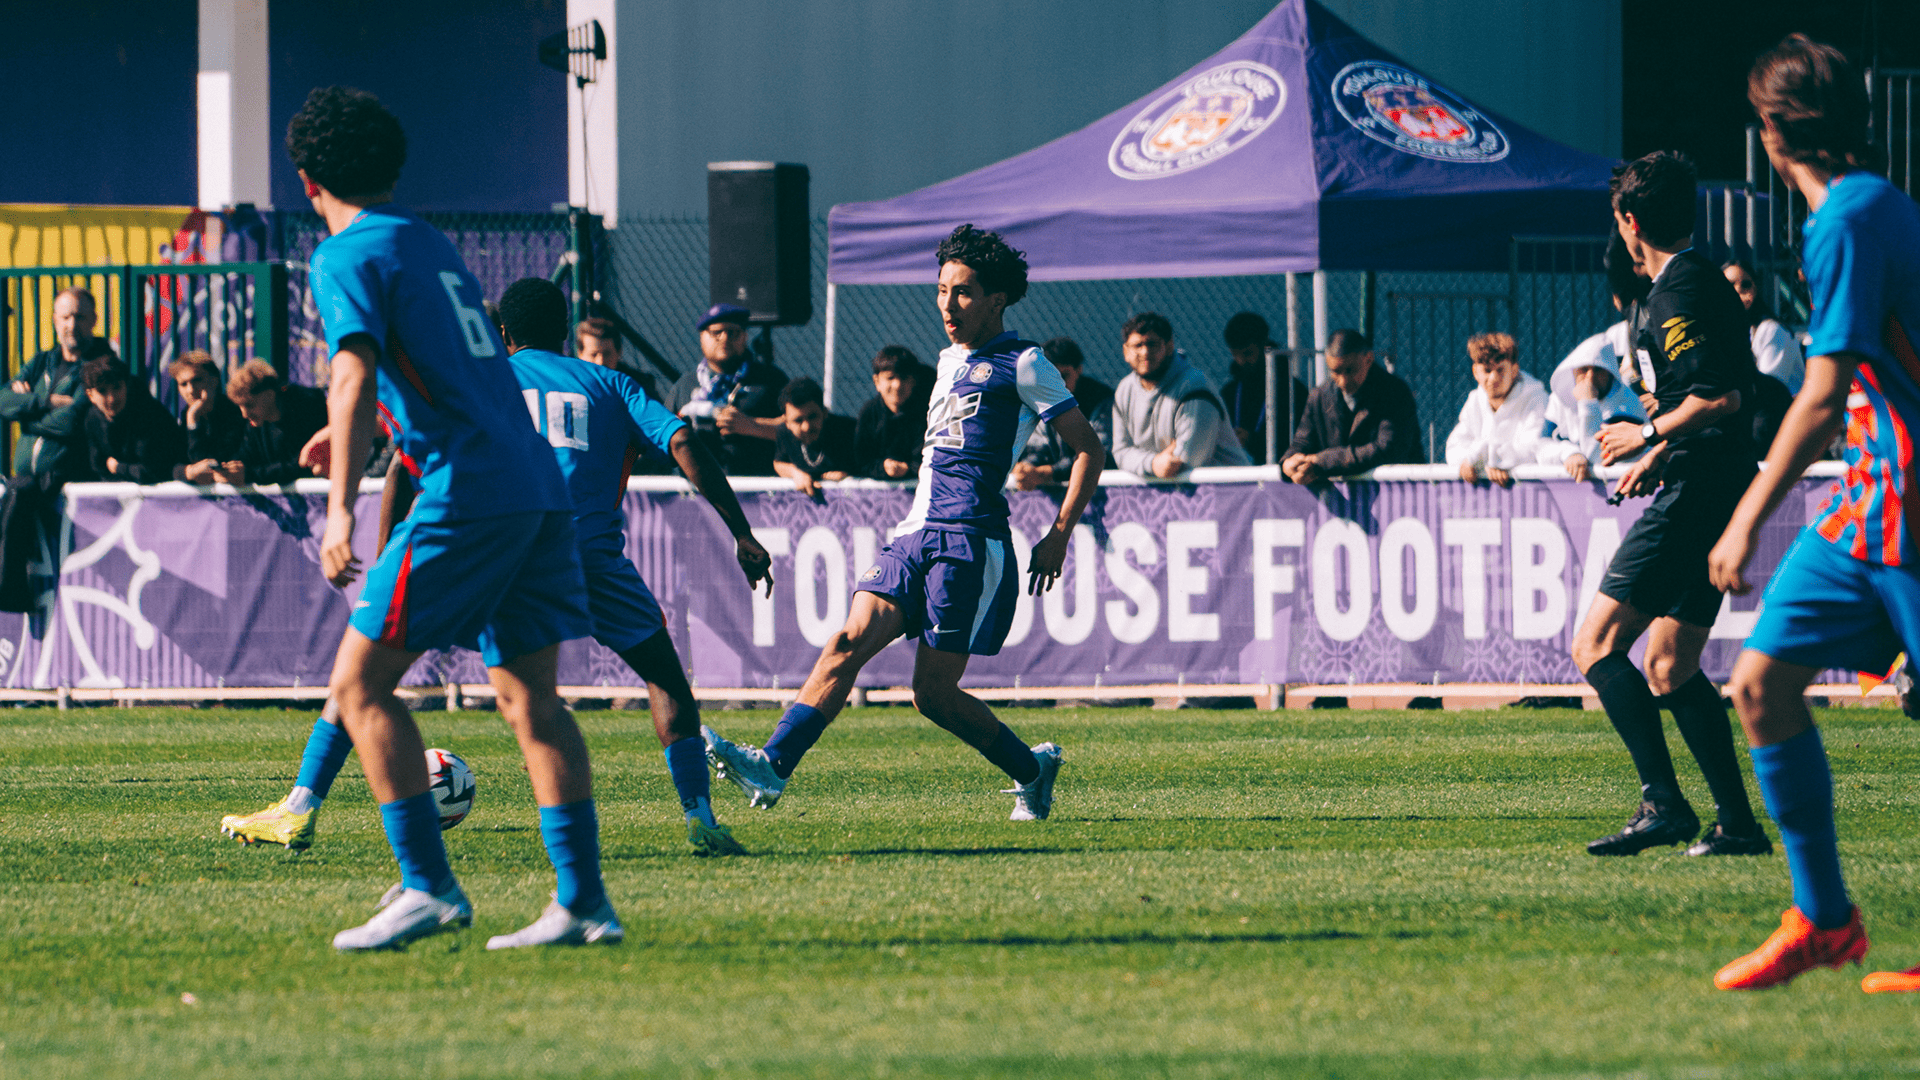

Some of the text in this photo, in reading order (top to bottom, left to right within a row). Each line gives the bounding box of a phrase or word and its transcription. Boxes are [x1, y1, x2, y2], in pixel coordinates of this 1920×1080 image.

[438, 269, 497, 358] 6
[734, 516, 1766, 648] TOUSE FOOTBA
